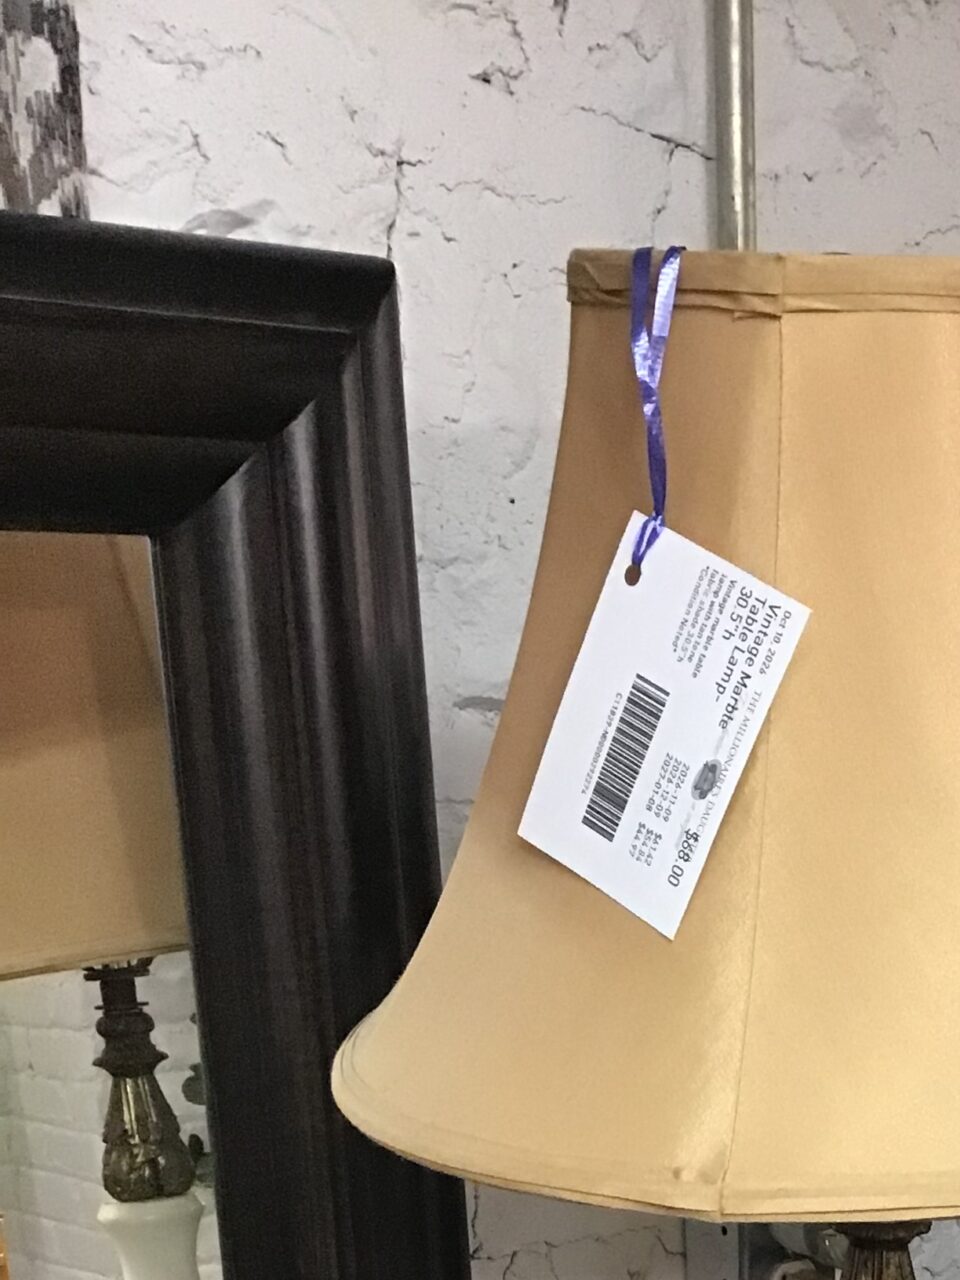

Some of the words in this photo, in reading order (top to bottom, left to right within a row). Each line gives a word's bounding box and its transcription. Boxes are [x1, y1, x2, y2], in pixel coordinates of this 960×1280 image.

[702, 568, 720, 598] fabric
[712, 573, 728, 599] lamp
[717, 578, 738, 616] Vintage
[690, 599, 706, 630] shade
[703, 600, 716, 622] with
[722, 586, 753, 642] 30.5"h
[738, 595, 767, 644] Table
[778, 609, 792, 629] Oct
[696, 622, 708, 640] tan
[702, 616, 721, 652] marble
[743, 601, 781, 668] Vintage
[687, 640, 701, 664] tone
[692, 653, 707, 679] table
[759, 647, 776, 676] 2026
[713, 644, 745, 703] Lamp-
[718, 670, 752, 731] Marble
[645, 752, 674, 812] 2027-01-08
[653, 758, 682, 818] 2026-12-09
[662, 763, 690, 823] 2026-11-09
[666, 828, 700, 888] $68.00
